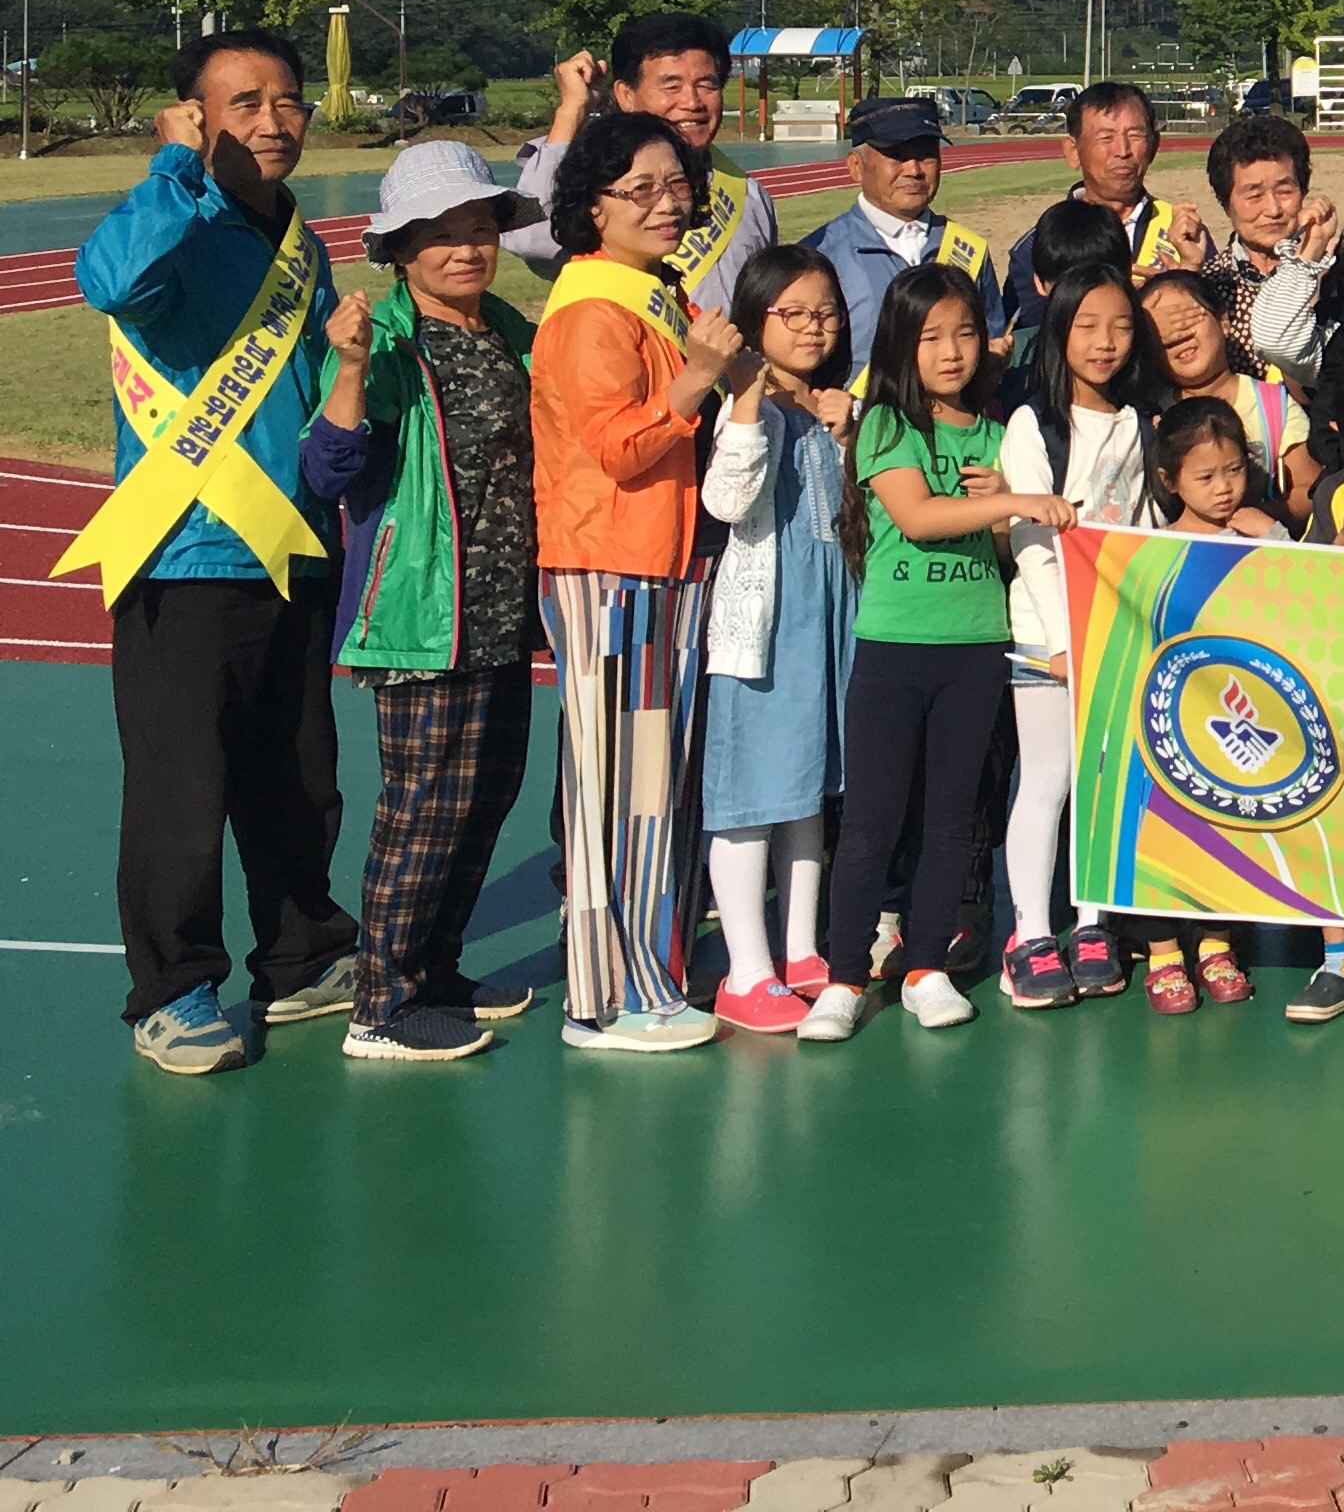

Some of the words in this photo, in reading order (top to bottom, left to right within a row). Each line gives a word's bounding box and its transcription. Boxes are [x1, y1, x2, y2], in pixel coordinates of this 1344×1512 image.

[170, 335, 277, 467] 남양면위원회
[893, 560, 910, 581] &
[926, 559, 996, 583] BACK
